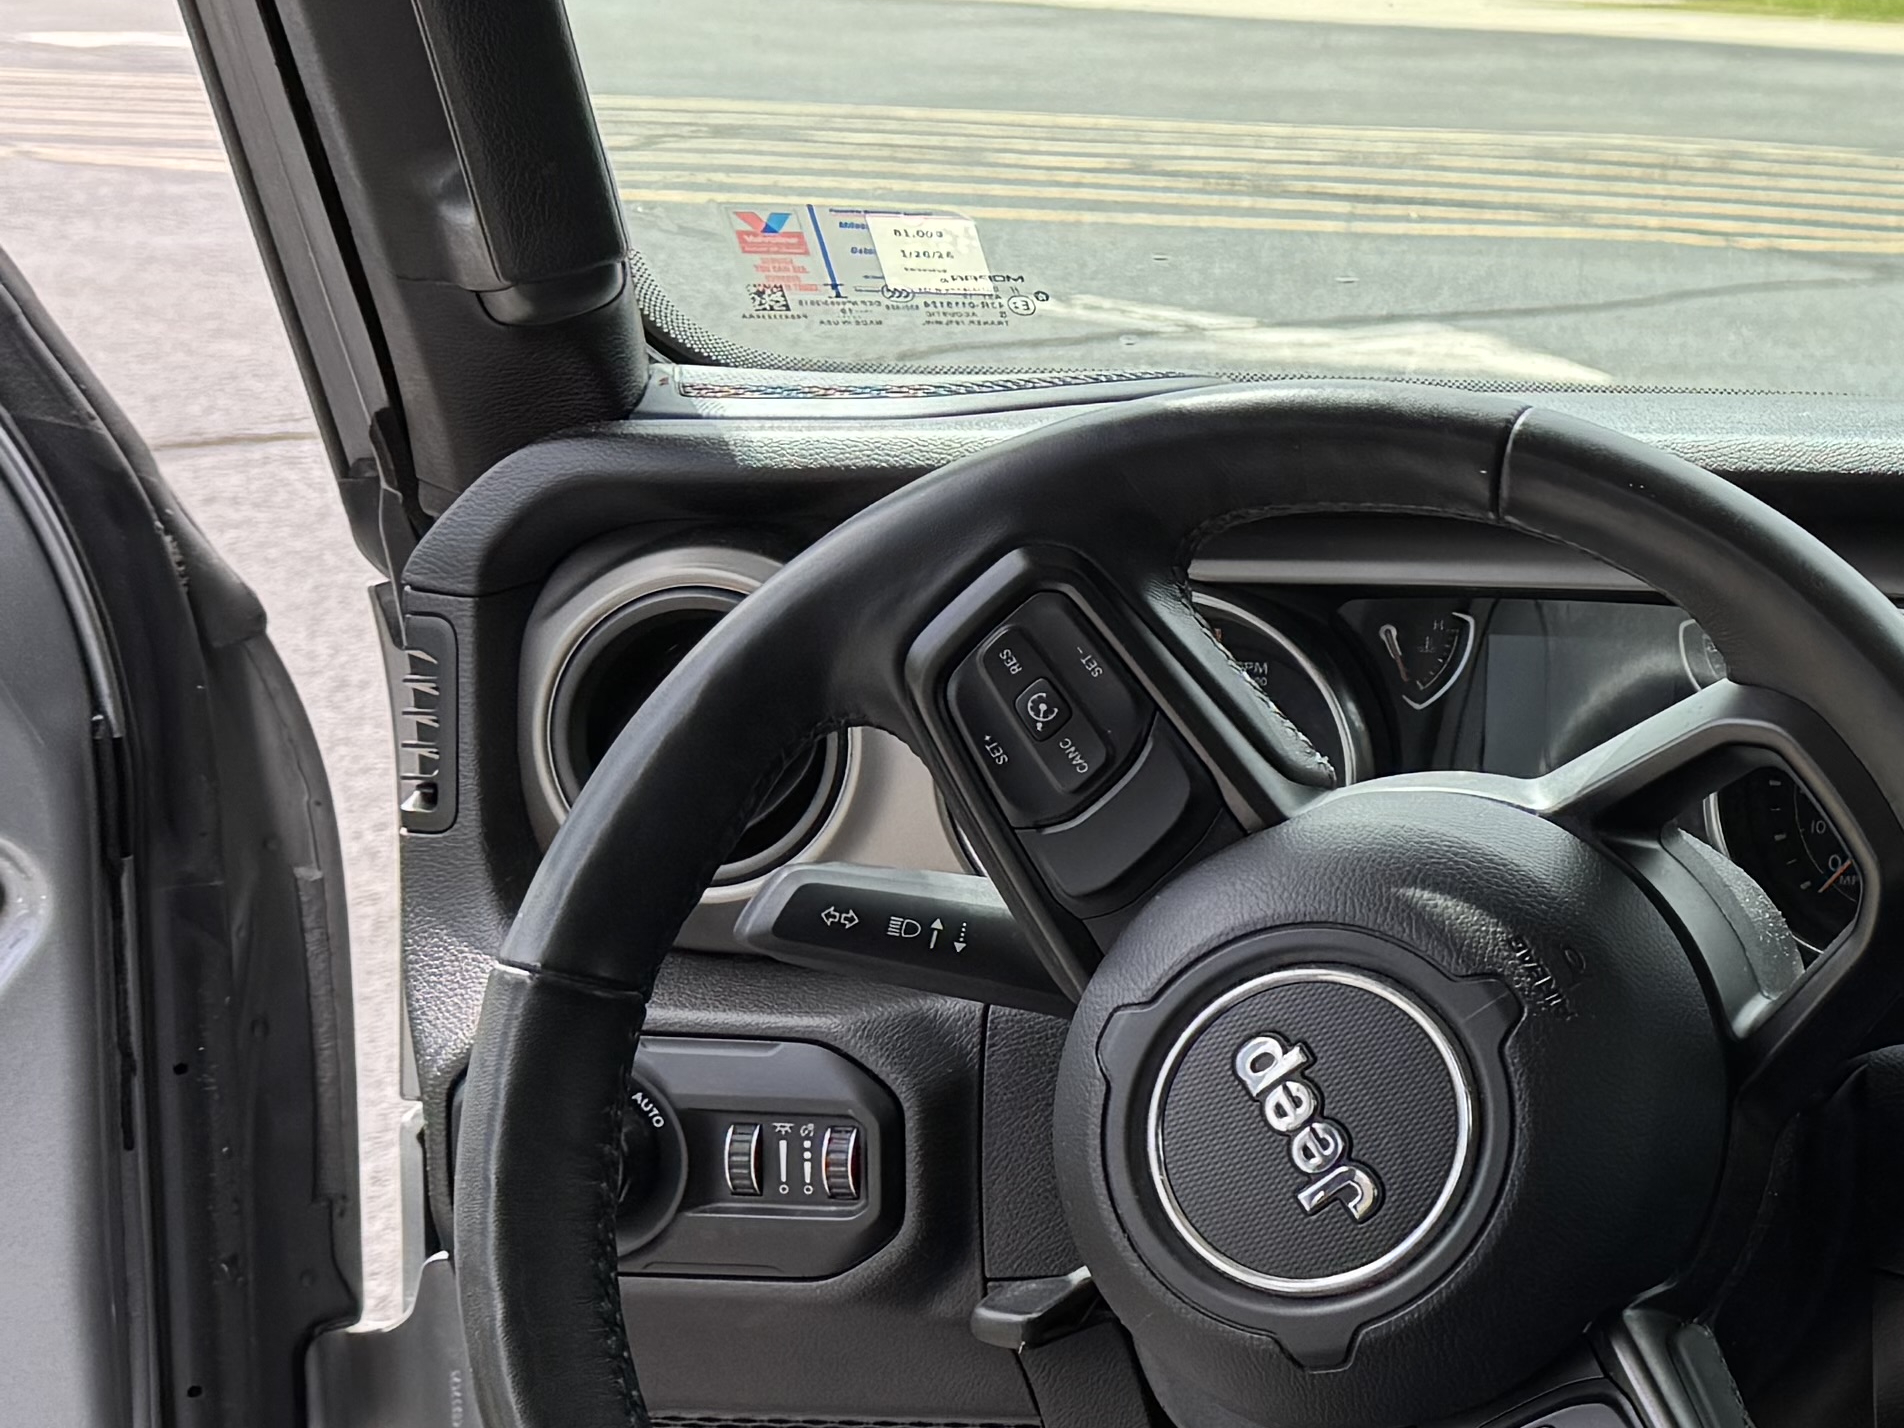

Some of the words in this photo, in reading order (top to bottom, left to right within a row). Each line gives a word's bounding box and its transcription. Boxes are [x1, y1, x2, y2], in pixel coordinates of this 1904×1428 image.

[998, 647, 1023, 675] RES
[1058, 737, 1089, 774] CANC
[1810, 819, 1827, 834] 10
[630, 1091, 665, 1128] AUTO
[1234, 1034, 1384, 1226] Jeep
